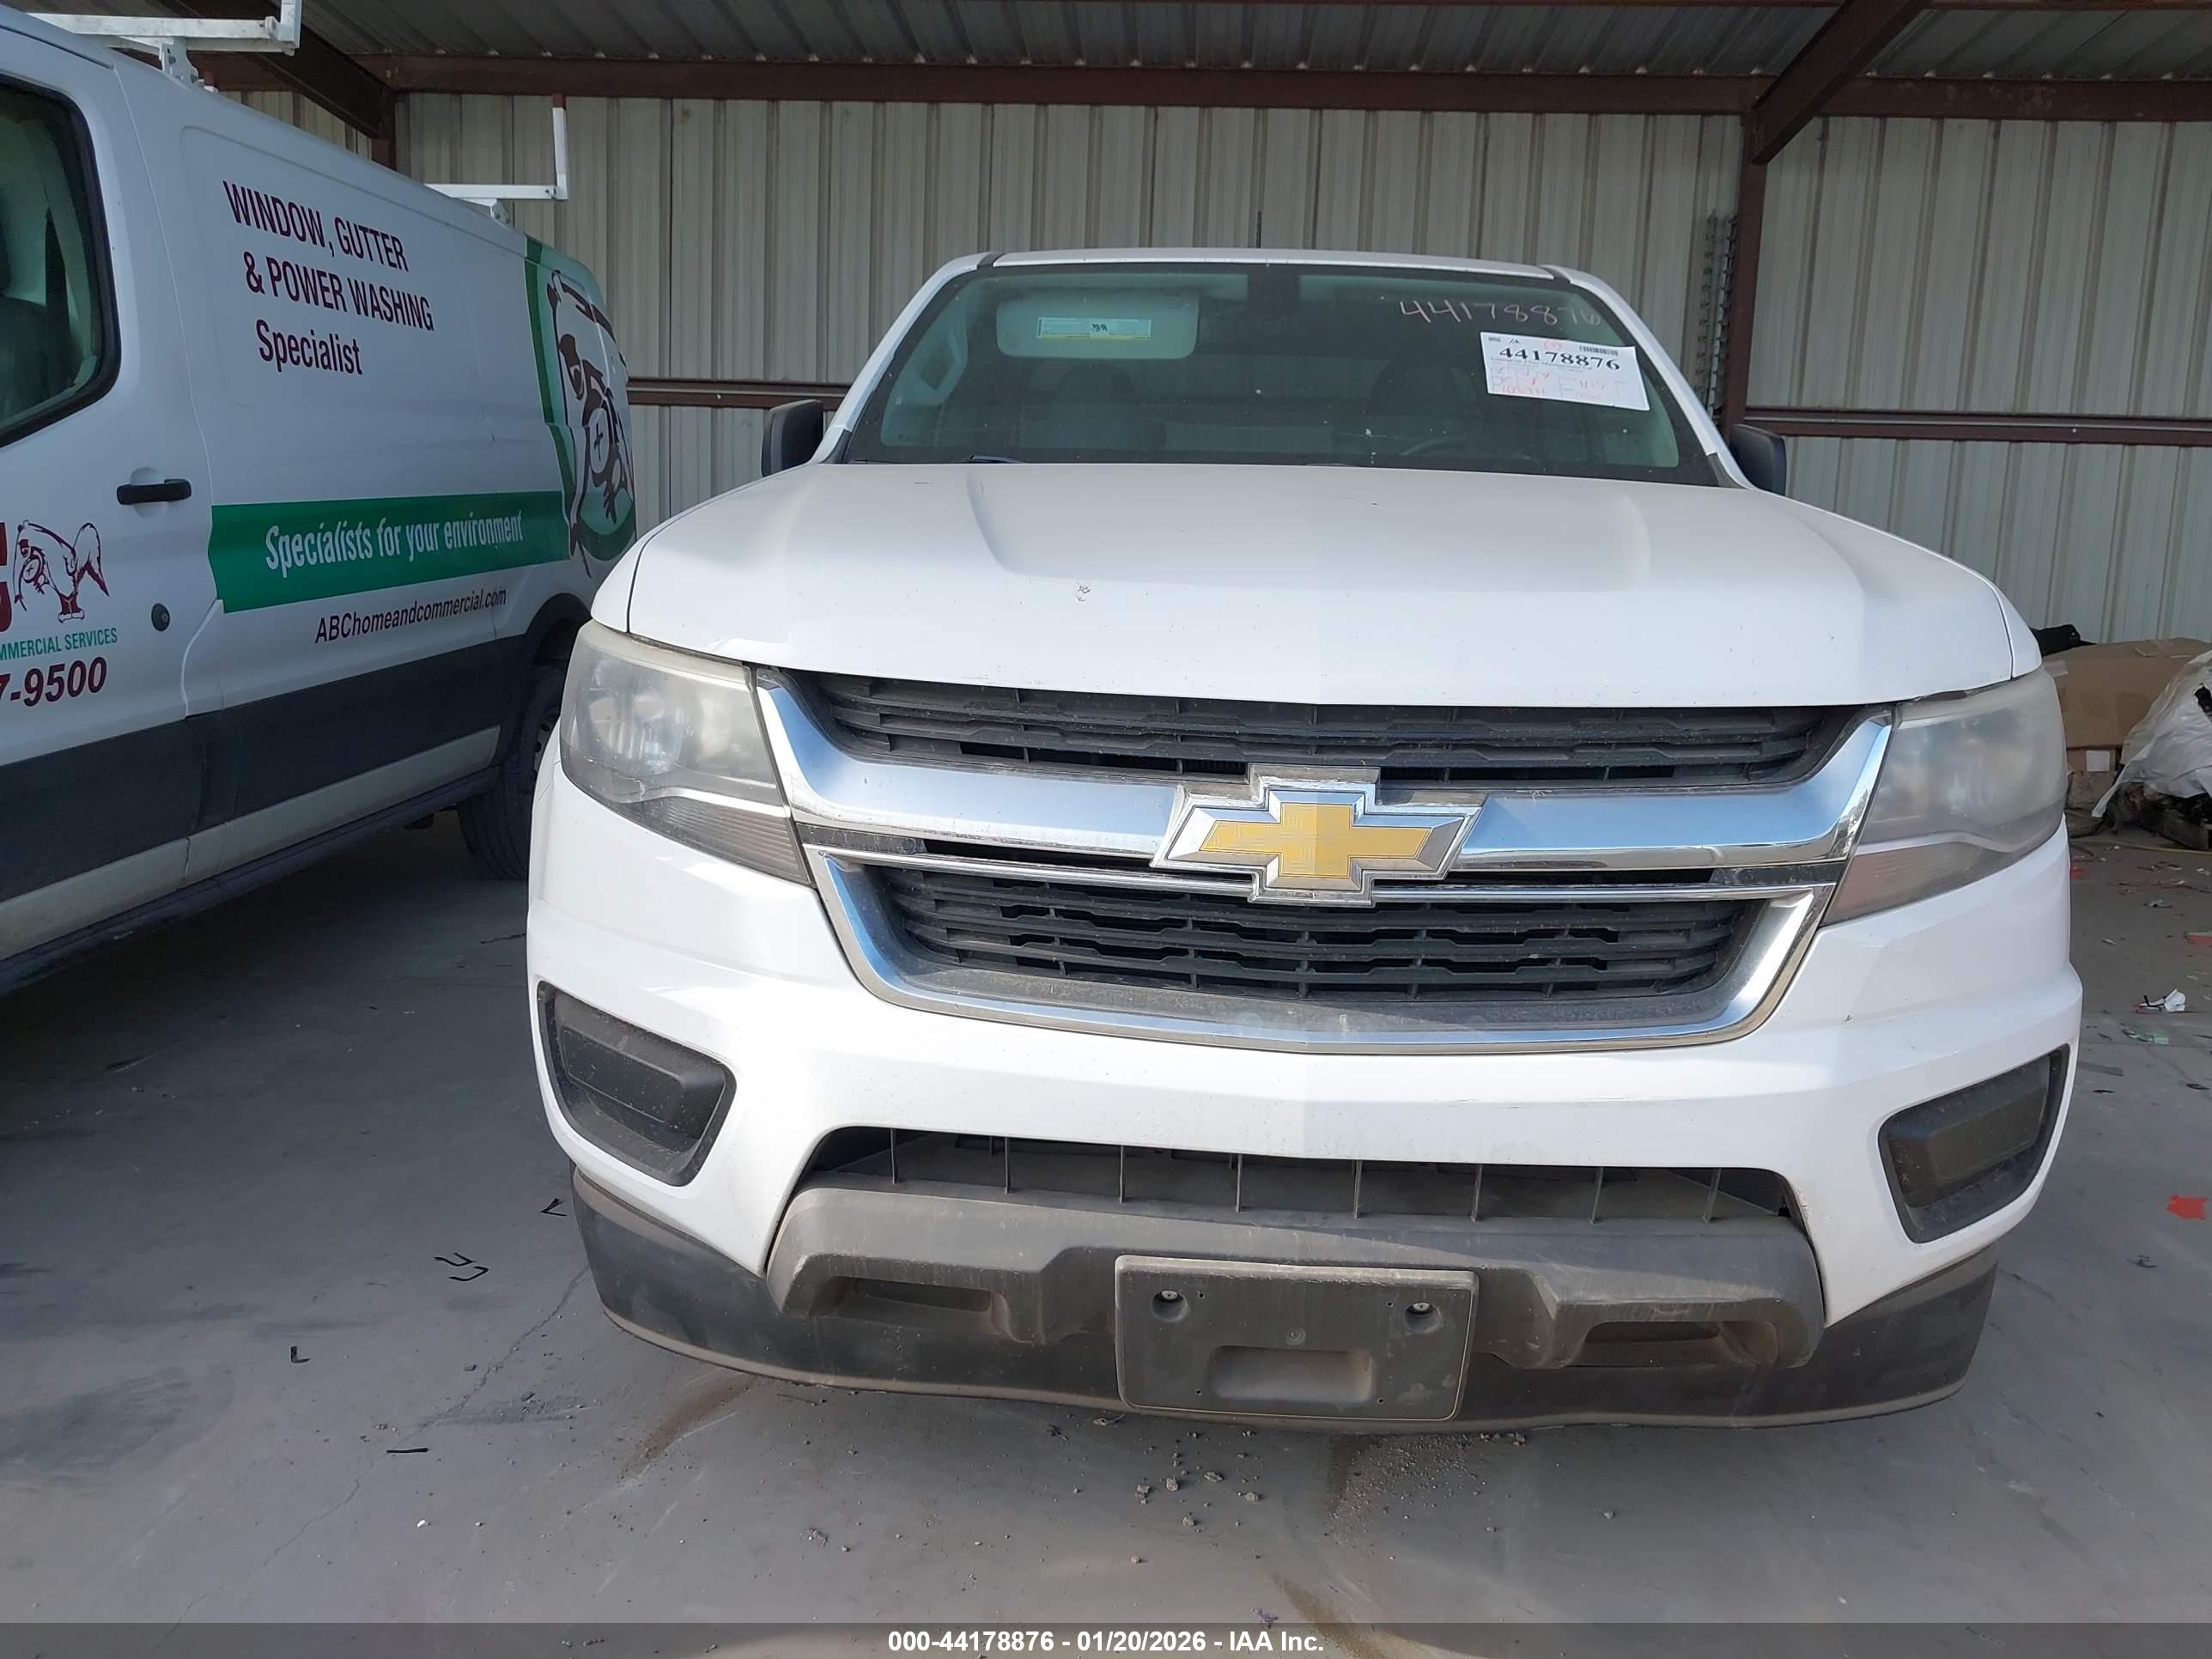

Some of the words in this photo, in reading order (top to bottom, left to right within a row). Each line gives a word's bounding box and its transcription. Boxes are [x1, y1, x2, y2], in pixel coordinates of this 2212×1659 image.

[223, 180, 335, 258] WINDOW,
[334, 216, 409, 272] GUTTER
[244, 251, 265, 295] &
[265, 256, 348, 313] POWER
[347, 276, 434, 331] WASHING
[1400, 300, 1601, 325] 44178876
[256, 319, 363, 375] Specialist
[1498, 347, 1620, 371] 44178876
[265, 520, 373, 578] Specialists
[376, 517, 402, 557] for
[406, 521, 441, 562] your
[443, 509, 524, 550] environment
[64, 627, 118, 651] SERVICES
[315, 587, 507, 644] ABChomeandcommercial.com
